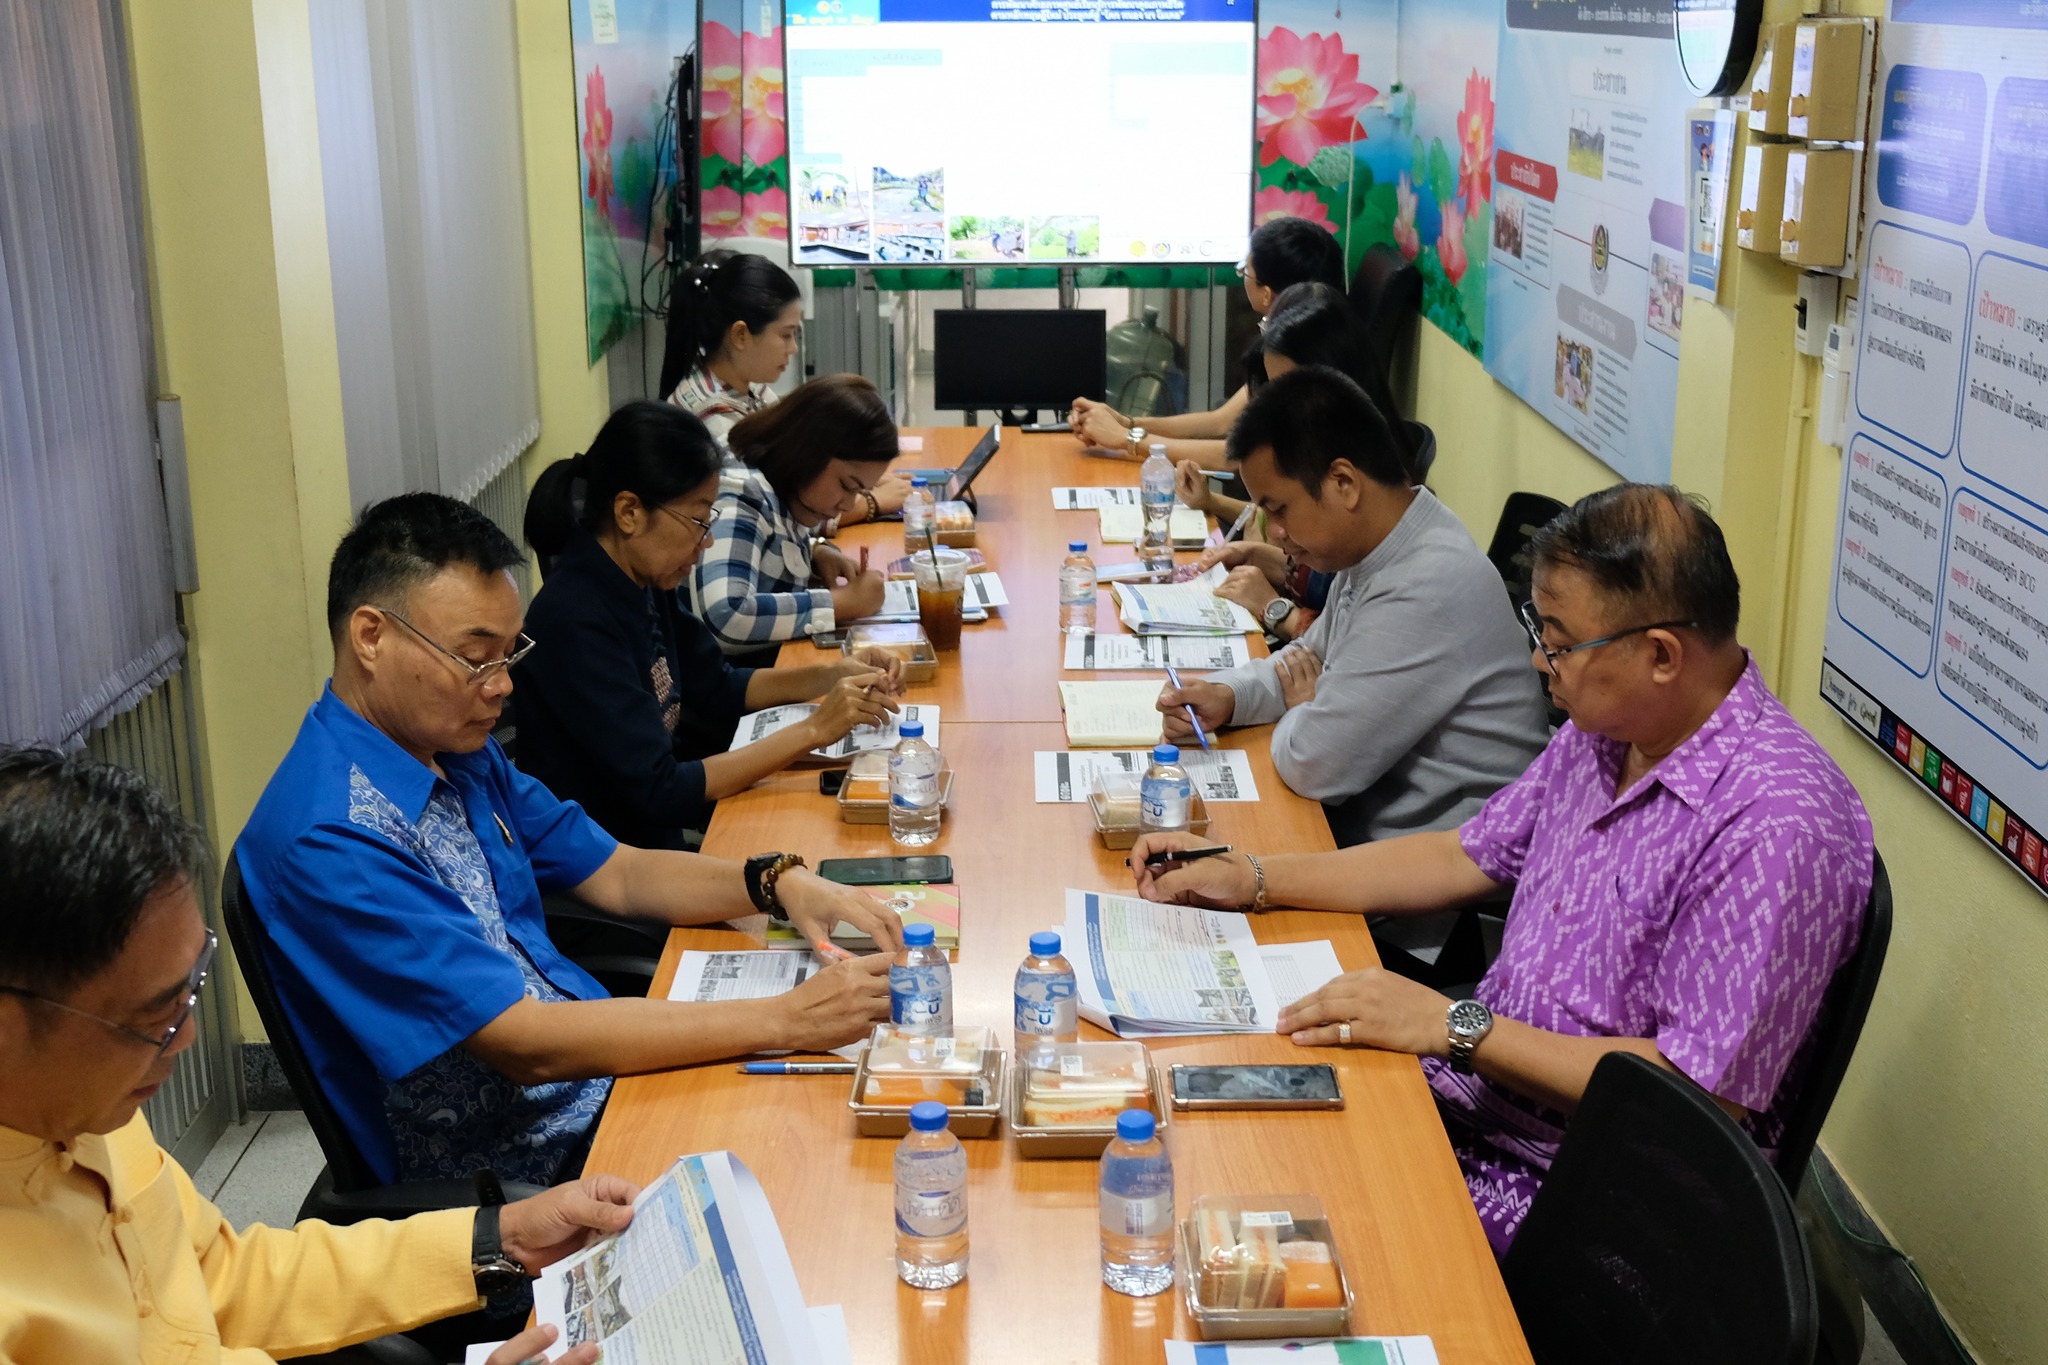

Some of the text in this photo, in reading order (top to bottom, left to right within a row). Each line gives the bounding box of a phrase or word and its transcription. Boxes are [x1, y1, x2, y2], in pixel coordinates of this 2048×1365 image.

[1979, 290, 2016, 329] เป้าหมาย
[2018, 571, 2036, 593] BCG
[1860, 702, 1878, 727] Good
